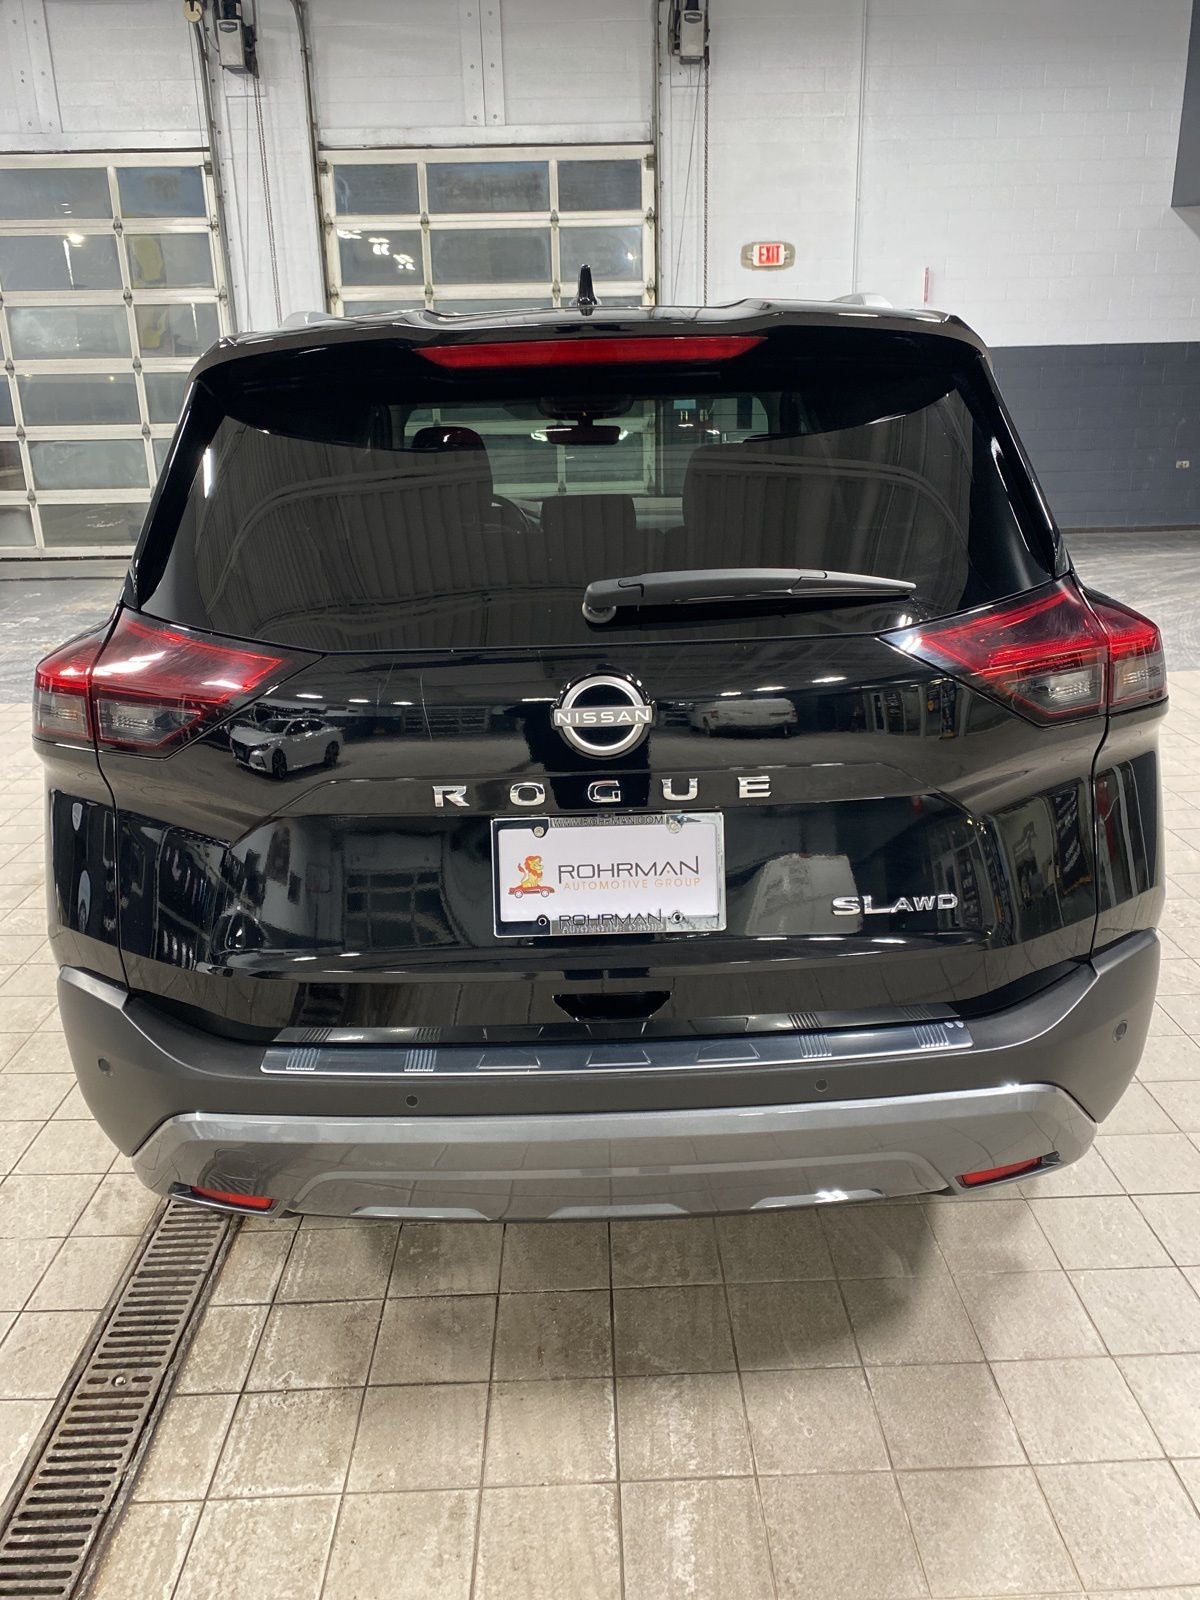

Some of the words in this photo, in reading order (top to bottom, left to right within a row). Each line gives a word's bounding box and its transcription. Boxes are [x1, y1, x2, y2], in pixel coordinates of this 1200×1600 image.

[758, 245, 781, 264] EXIT
[557, 709, 650, 724] NISSAN
[432, 775, 771, 807] ROGUE
[558, 855, 700, 884] ROHRMAN
[563, 879, 649, 891] AUTOMOTIVE
[654, 877, 701, 888] GROUP
[558, 908, 662, 929] ROHRMAN
